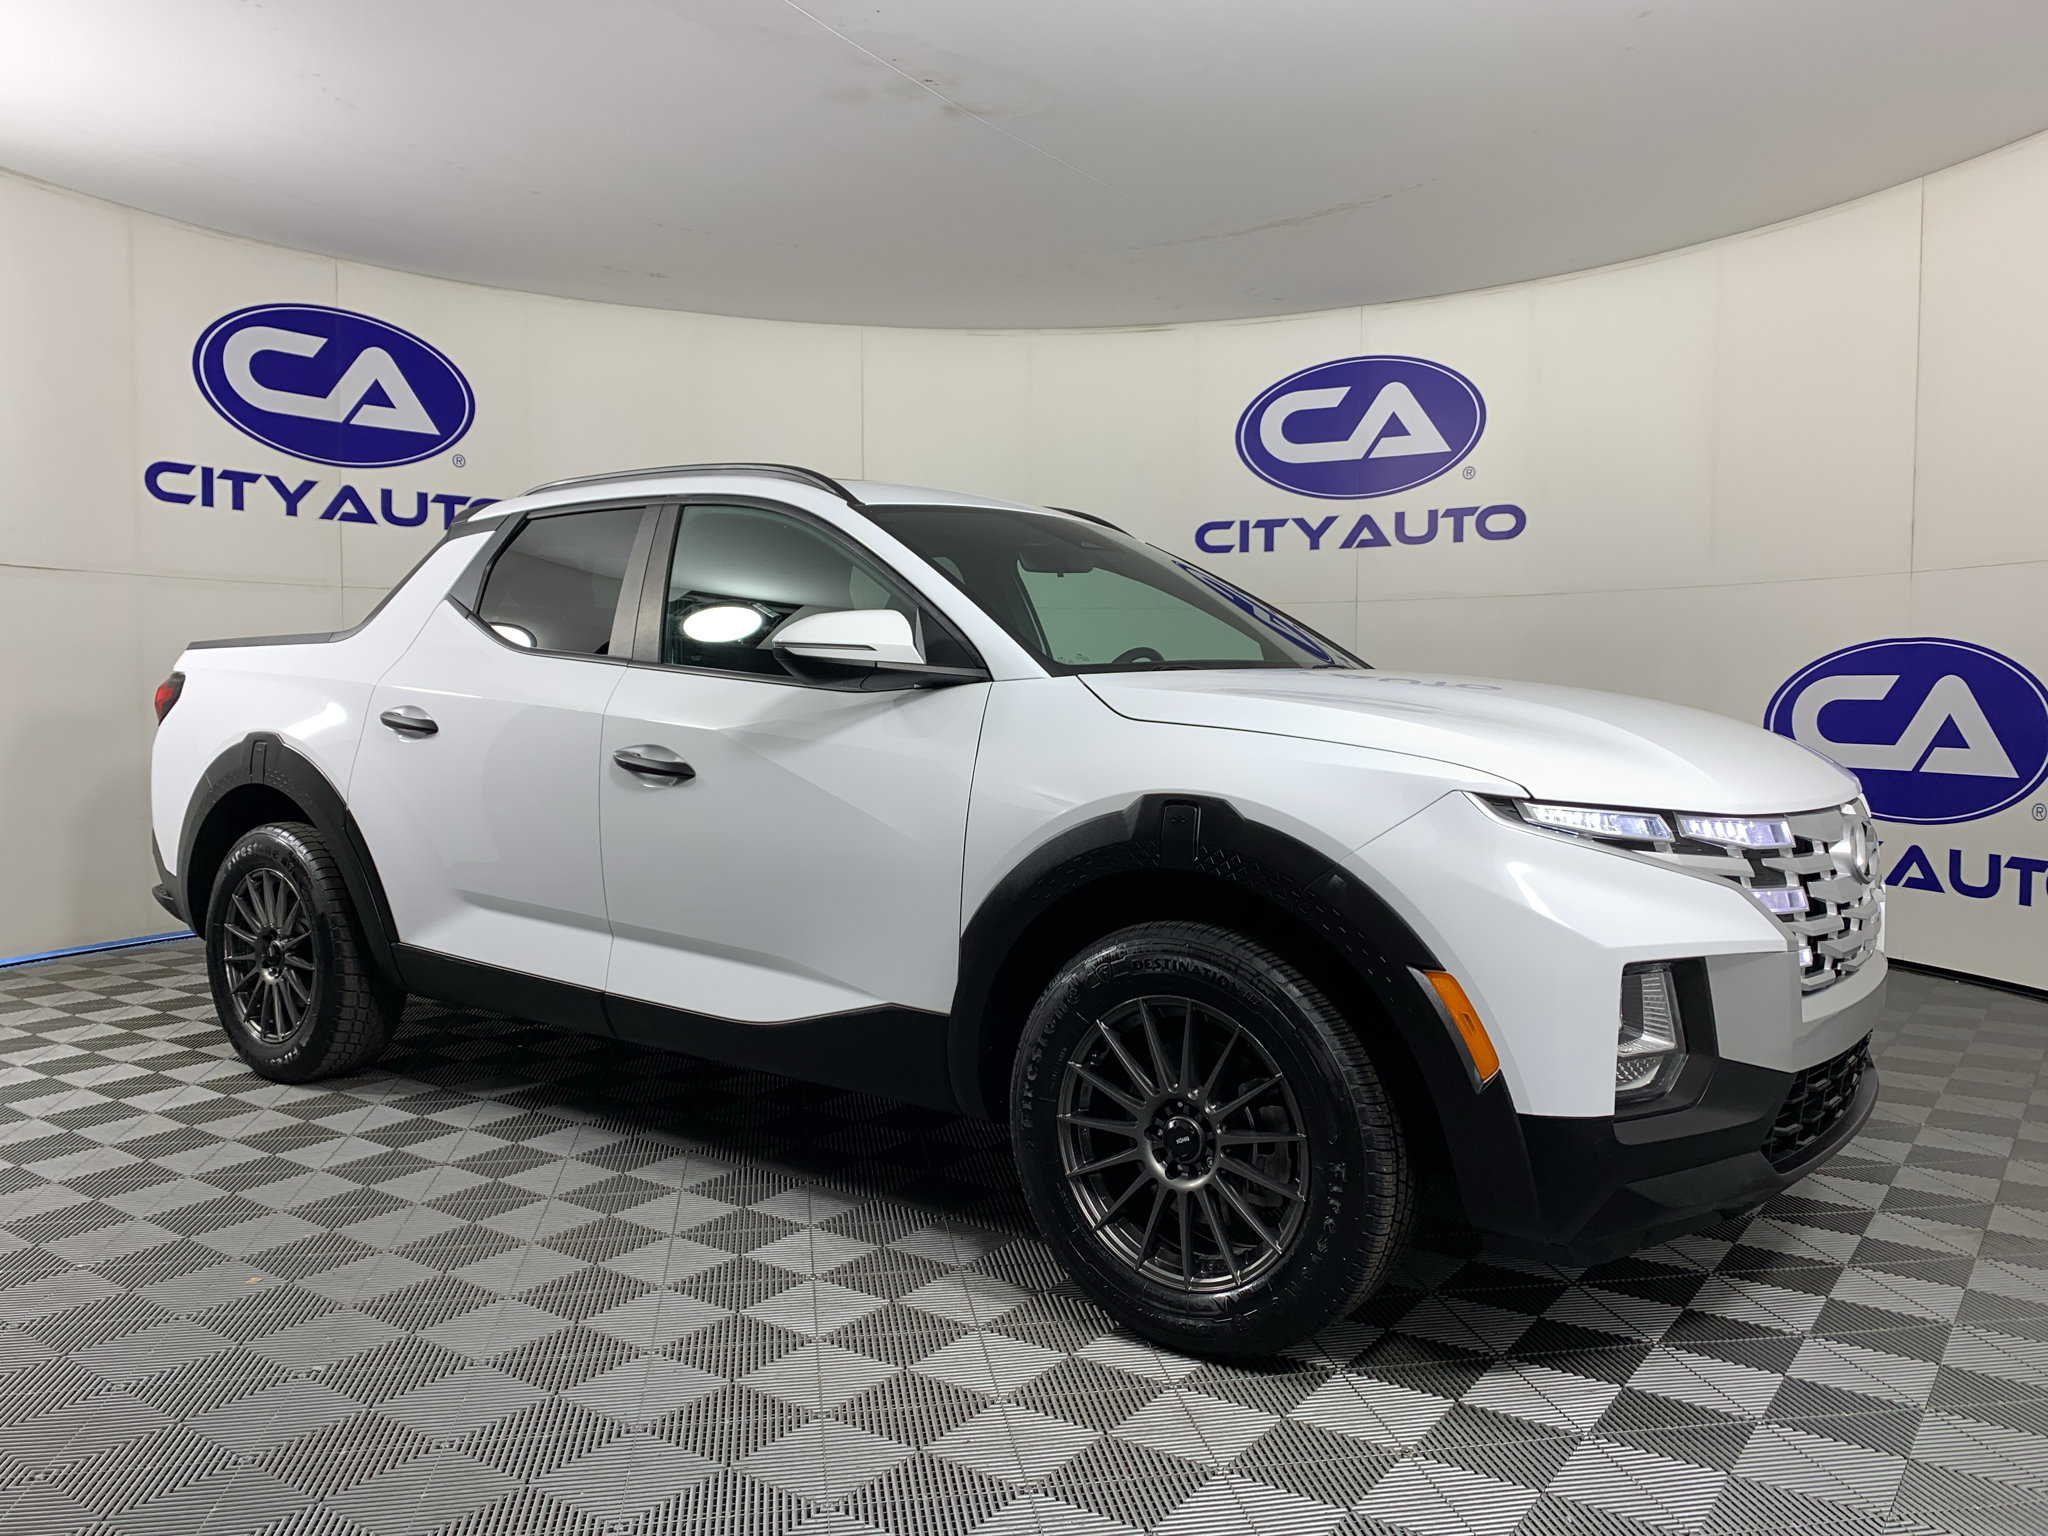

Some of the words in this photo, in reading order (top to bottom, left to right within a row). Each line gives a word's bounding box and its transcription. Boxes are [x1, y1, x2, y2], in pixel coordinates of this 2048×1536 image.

[222, 326, 441, 436] CA
[1259, 381, 1452, 464] CA
[144, 461, 319, 516] CITY
[1194, 515, 1339, 553] CITY
[1339, 504, 1527, 549] AUTO
[1791, 674, 2021, 779] CA
[1884, 844, 2048, 907] AUT
